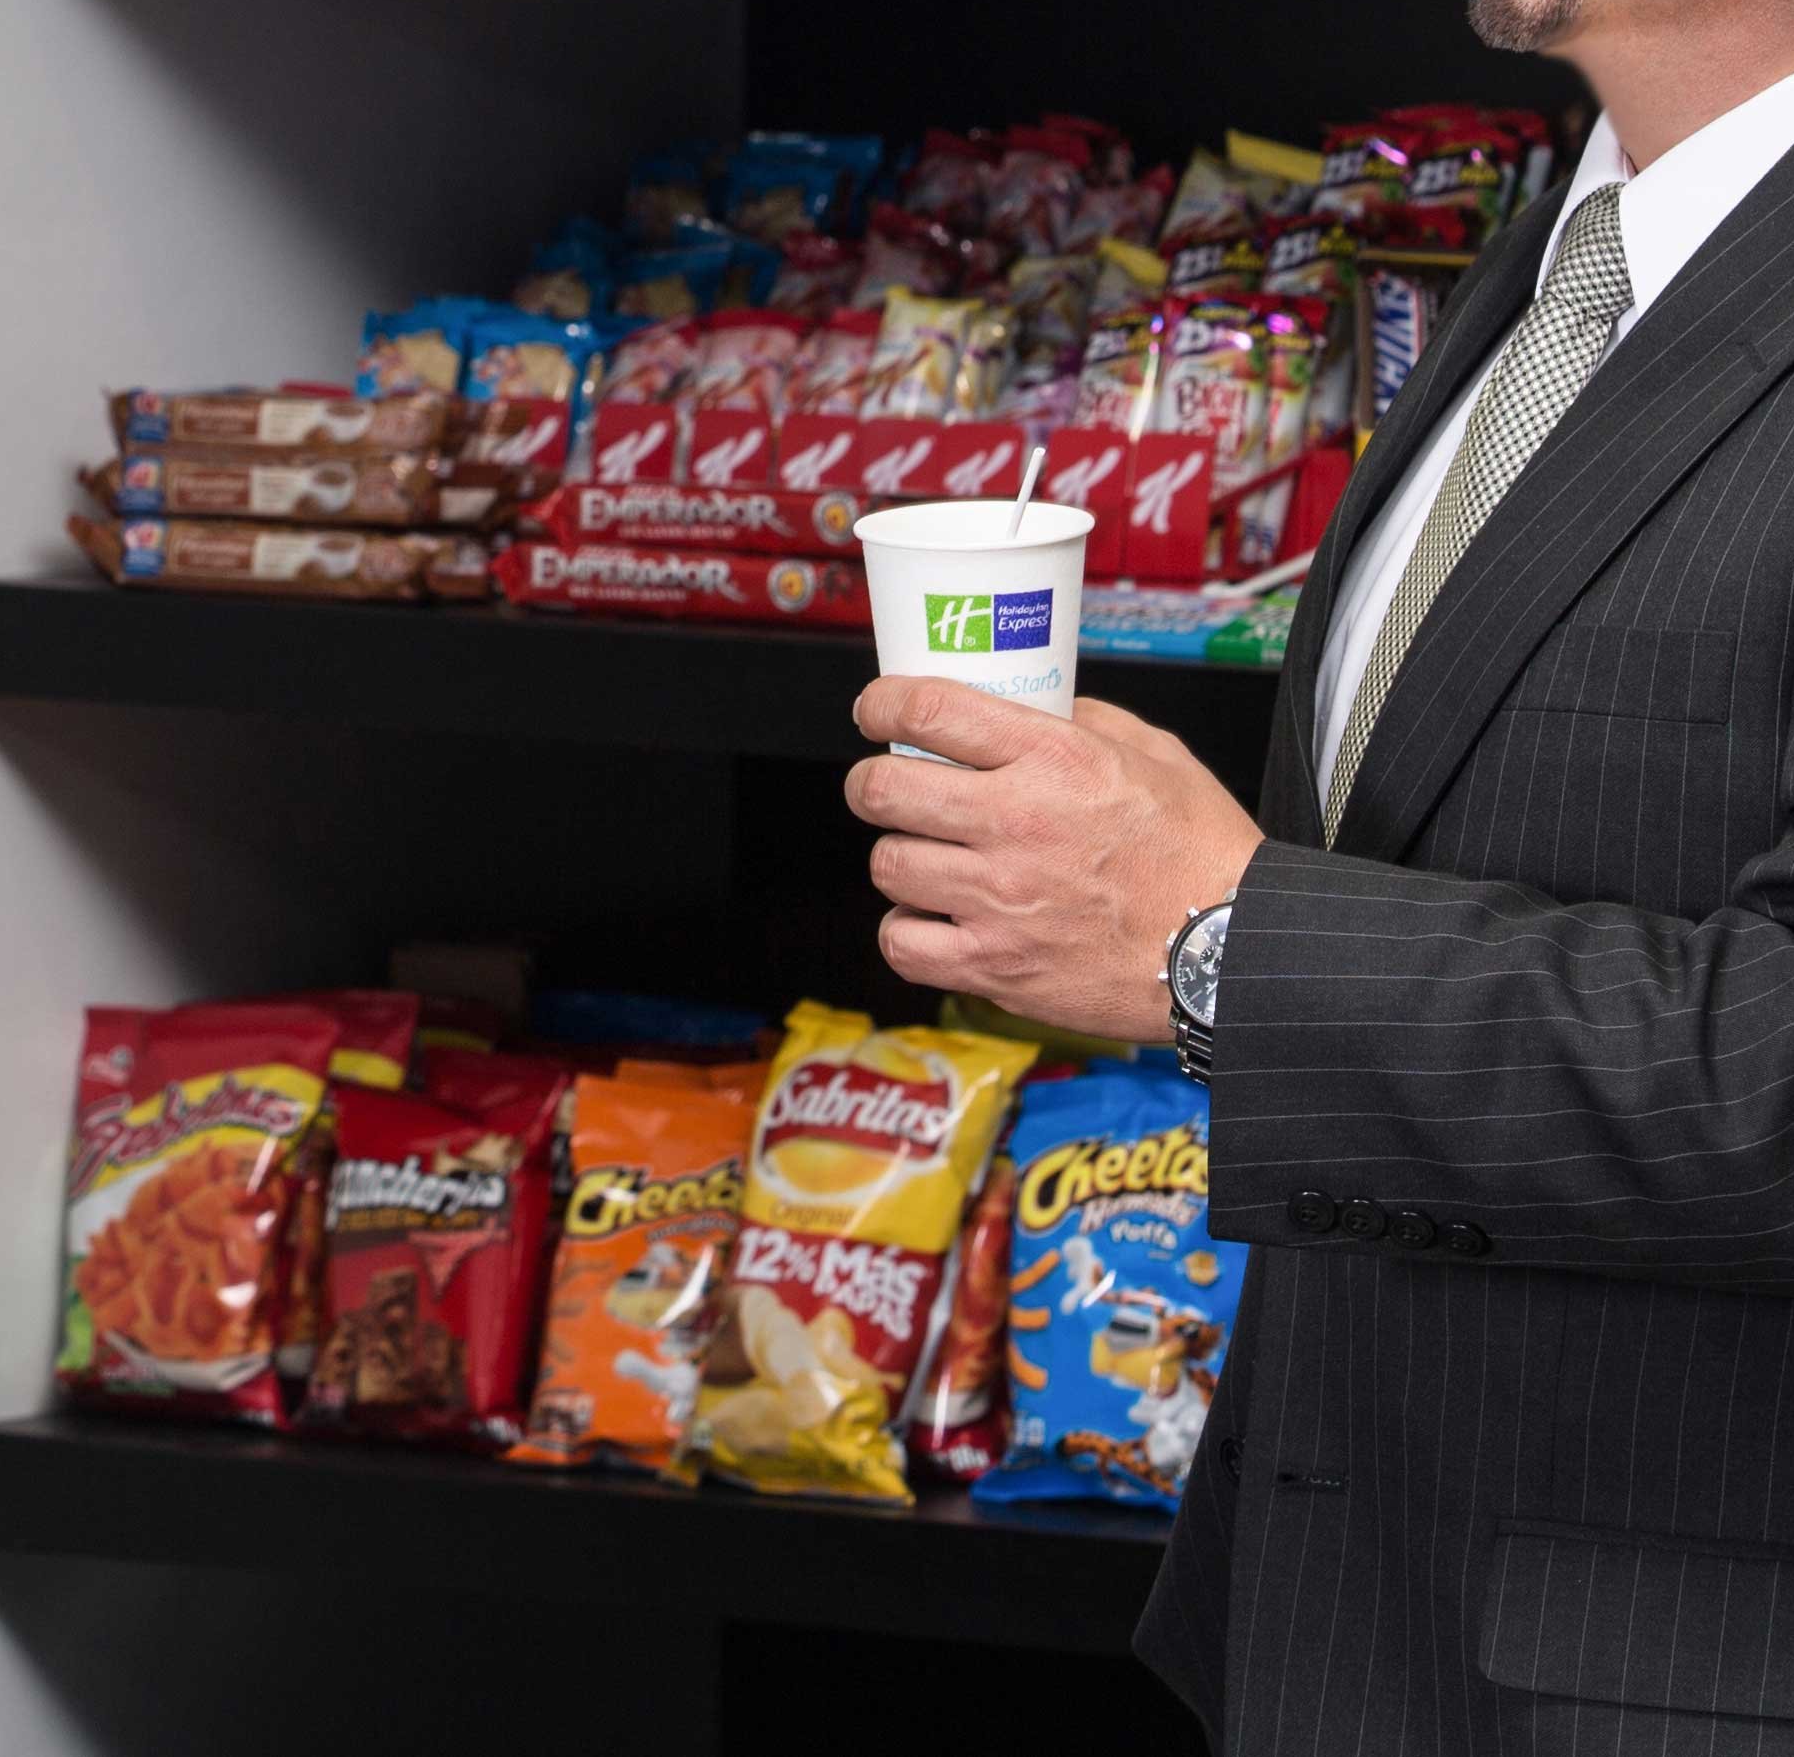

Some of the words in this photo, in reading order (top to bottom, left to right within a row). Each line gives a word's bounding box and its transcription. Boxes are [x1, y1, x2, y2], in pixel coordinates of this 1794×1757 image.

[998, 604, 1035, 618] Holiday
[1035, 602, 1050, 614] Inn
[998, 614, 1048, 633] Express
[767, 1070, 947, 1143] Sabritas
[734, 1227, 817, 1283] 12%
